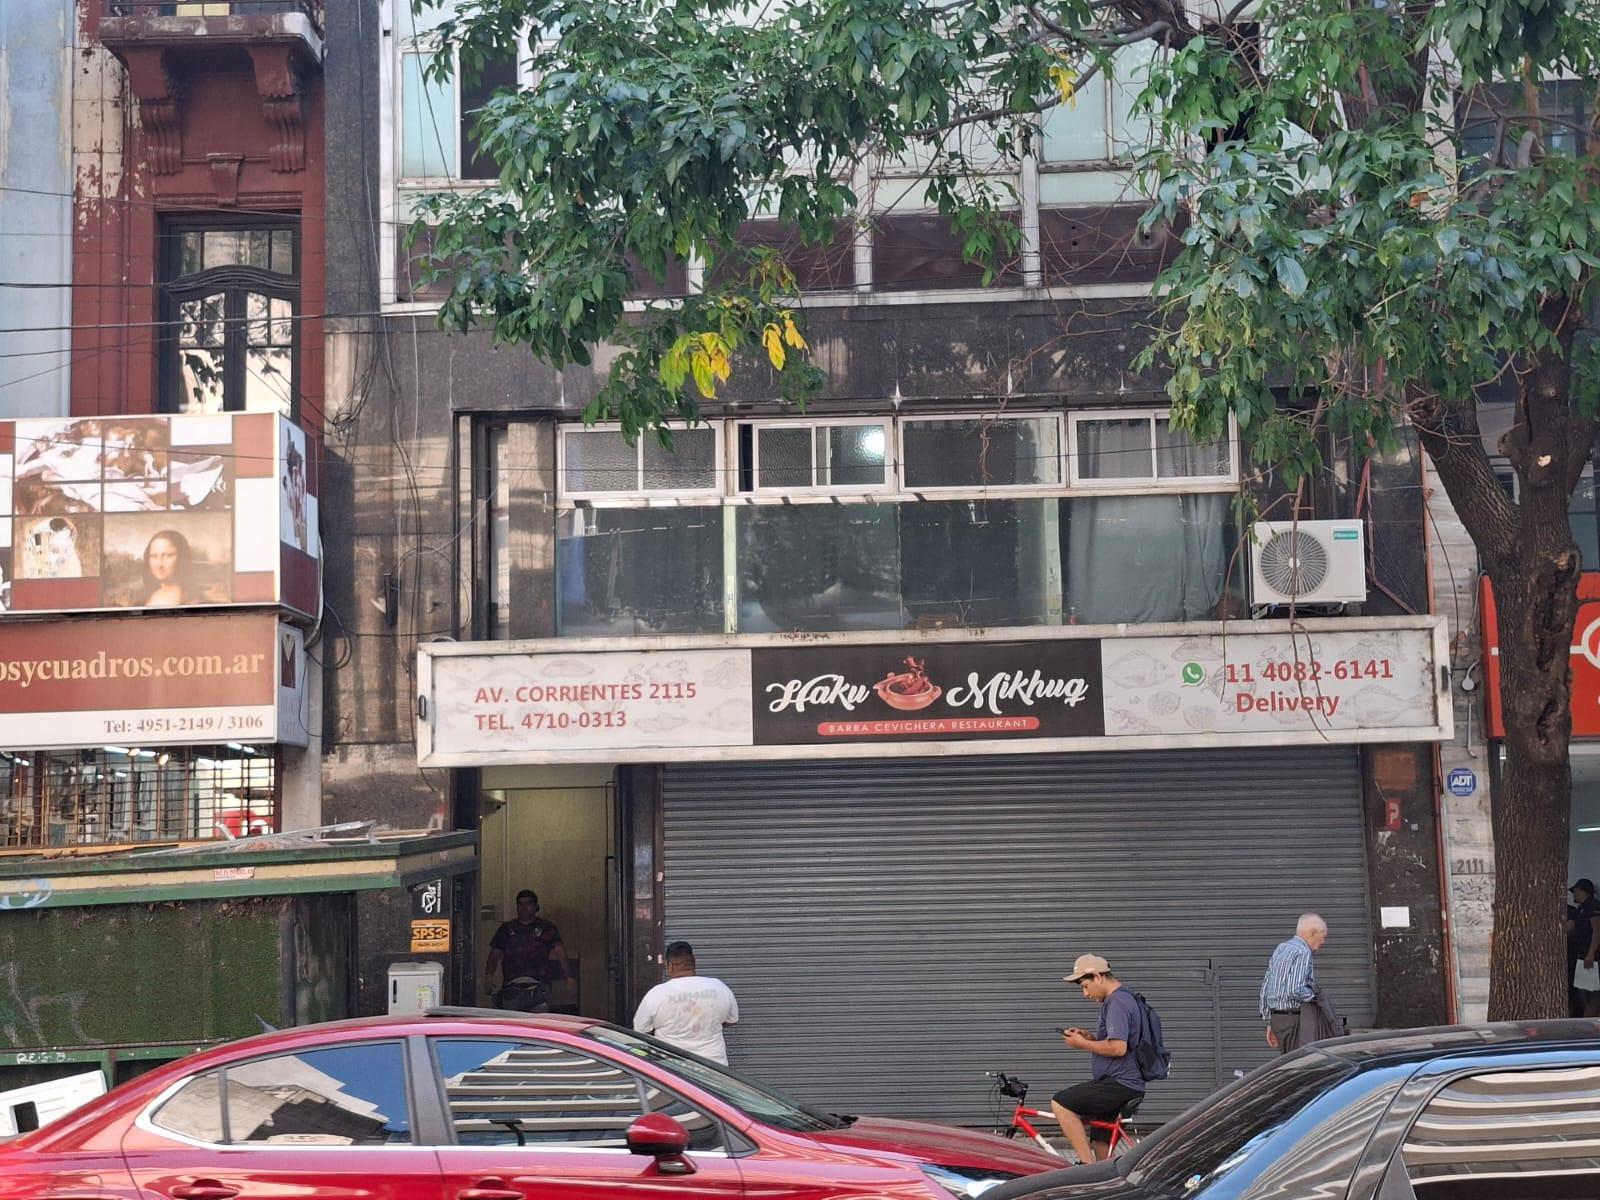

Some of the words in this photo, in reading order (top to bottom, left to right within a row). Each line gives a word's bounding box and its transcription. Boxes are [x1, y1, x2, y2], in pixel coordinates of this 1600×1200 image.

[1226, 663, 1254, 682] 11
[1262, 659, 1393, 681] 4082-6141
[475, 687, 508, 703] AV.
[516, 684, 642, 702] CORRIENTES
[649, 682, 697, 699] 2115
[765, 674, 870, 712] Haku
[1236, 691, 1341, 716] Delivery
[104, 720, 131, 733] Tel:
[136, 717, 214, 731] 4951-2149
[228, 716, 263, 729] 3106
[475, 714, 514, 730] TEL.
[521, 711, 627, 729] 4710-0313
[829, 724, 869, 733] BARRA
[875, 721, 945, 732] CEVICHERA
[951, 719, 1028, 730] RESTAURANT
[1452, 775, 1472, 787] ADT
[1456, 859, 1484, 873] 2111
